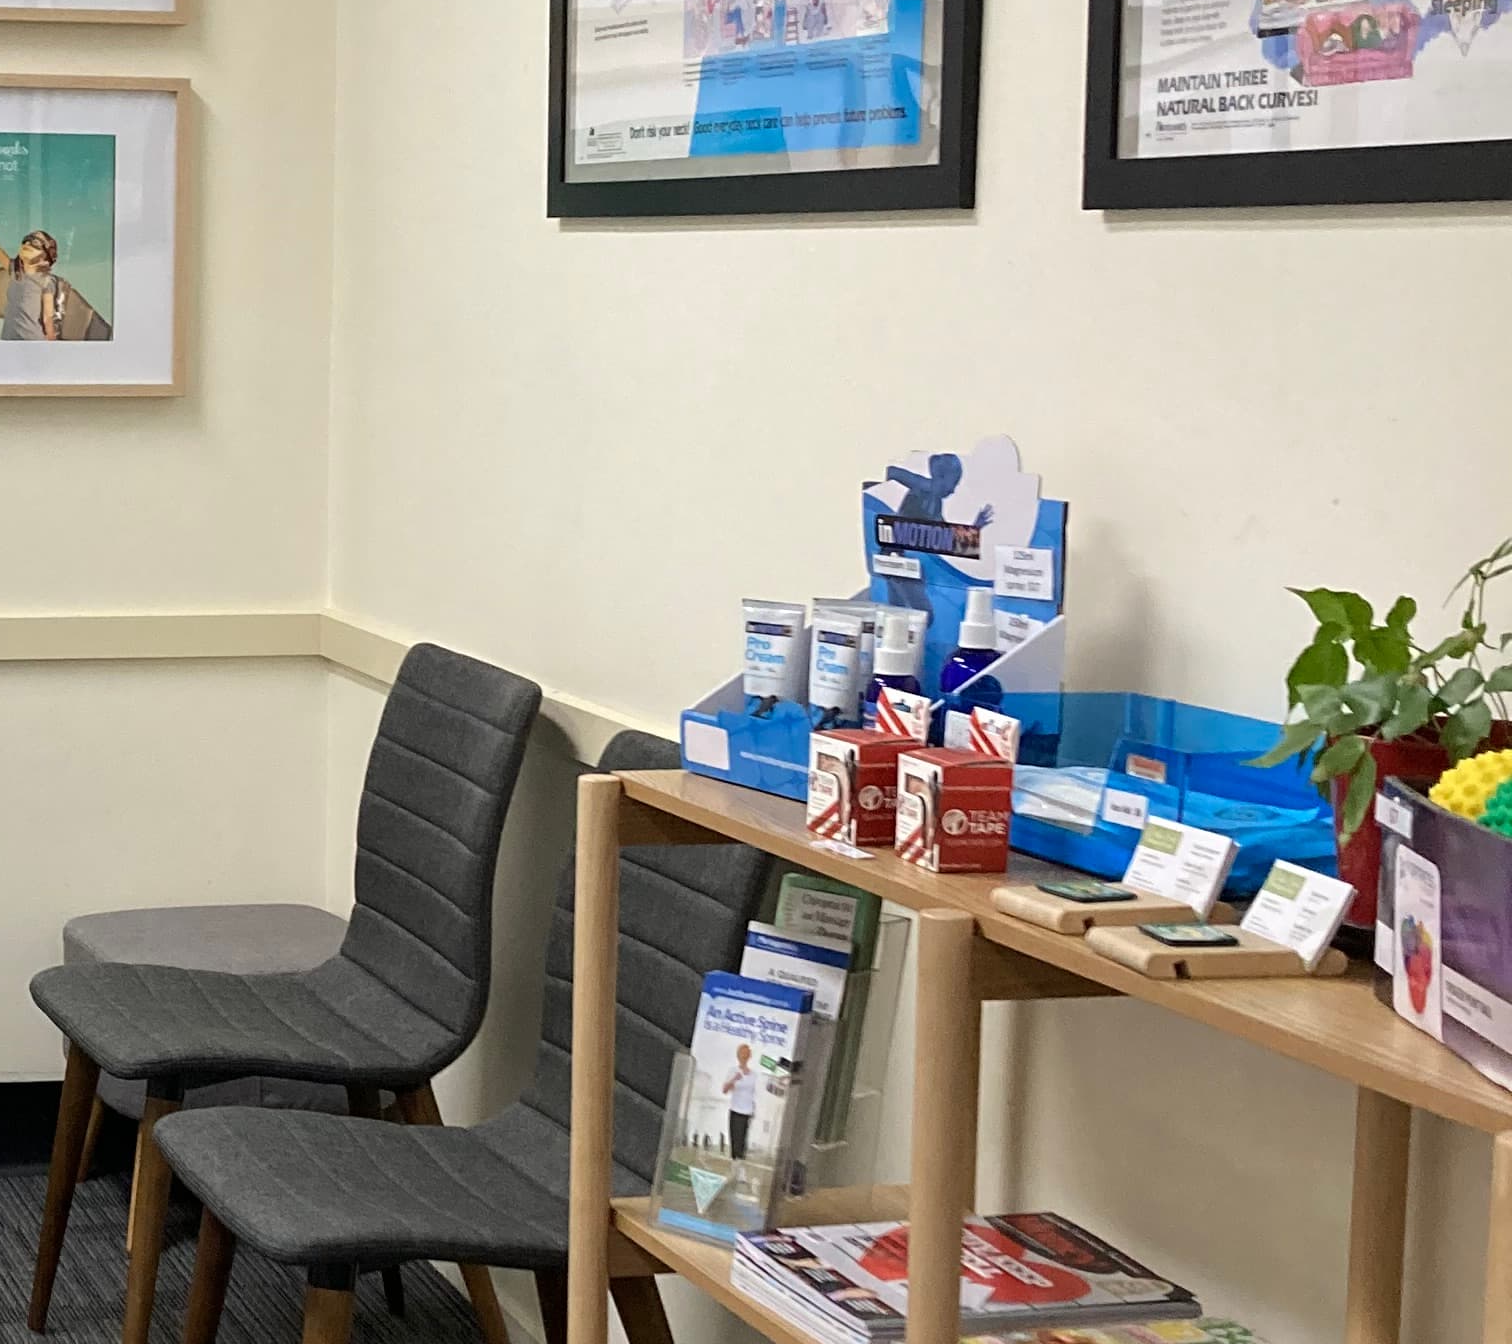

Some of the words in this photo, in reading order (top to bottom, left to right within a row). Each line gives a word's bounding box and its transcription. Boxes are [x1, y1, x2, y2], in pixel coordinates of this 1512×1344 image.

[1158, 73, 1221, 93] MAINTAIN
[1224, 69, 1268, 87] THREE
[1157, 96, 1216, 116] NATURAL
[1218, 93, 1255, 112] BACK
[1258, 89, 1318, 110] CURVES!
[747, 636, 772, 650] Pro
[745, 649, 785, 664] Cream
[969, 809, 1010, 820] TEAM
[968, 822, 1007, 835] TAPE
